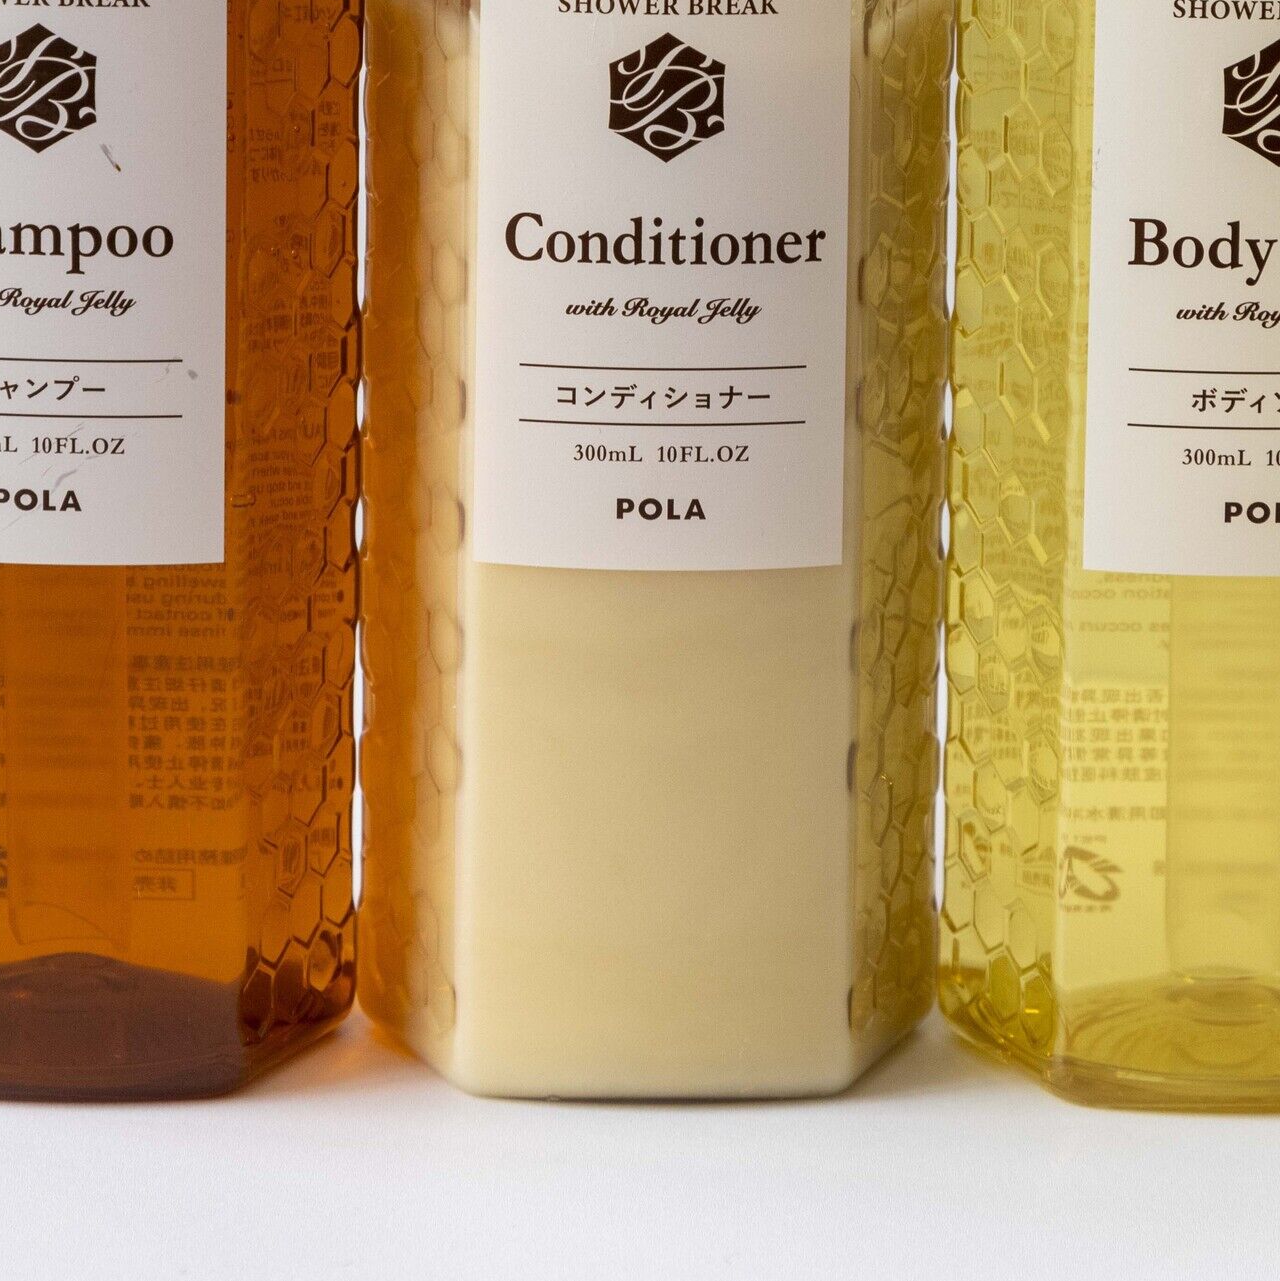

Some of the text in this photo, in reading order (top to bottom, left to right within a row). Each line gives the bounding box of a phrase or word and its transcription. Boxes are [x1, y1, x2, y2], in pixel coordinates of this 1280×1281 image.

[505, 212, 827, 266] Conditioner
[1127, 217, 1279, 287] Body
[70, 289, 137, 318] Jelly
[565, 297, 763, 325] with Royal Jelly
[1175, 301, 1230, 321] with
[557, 383, 771, 410] コンディショナー
[32, 436, 125, 455] 10FL.OZ
[573, 444, 750, 463] 300mL 10FL.OZ
[1182, 448, 1252, 466] 300mL
[616, 497, 707, 521] POLA
